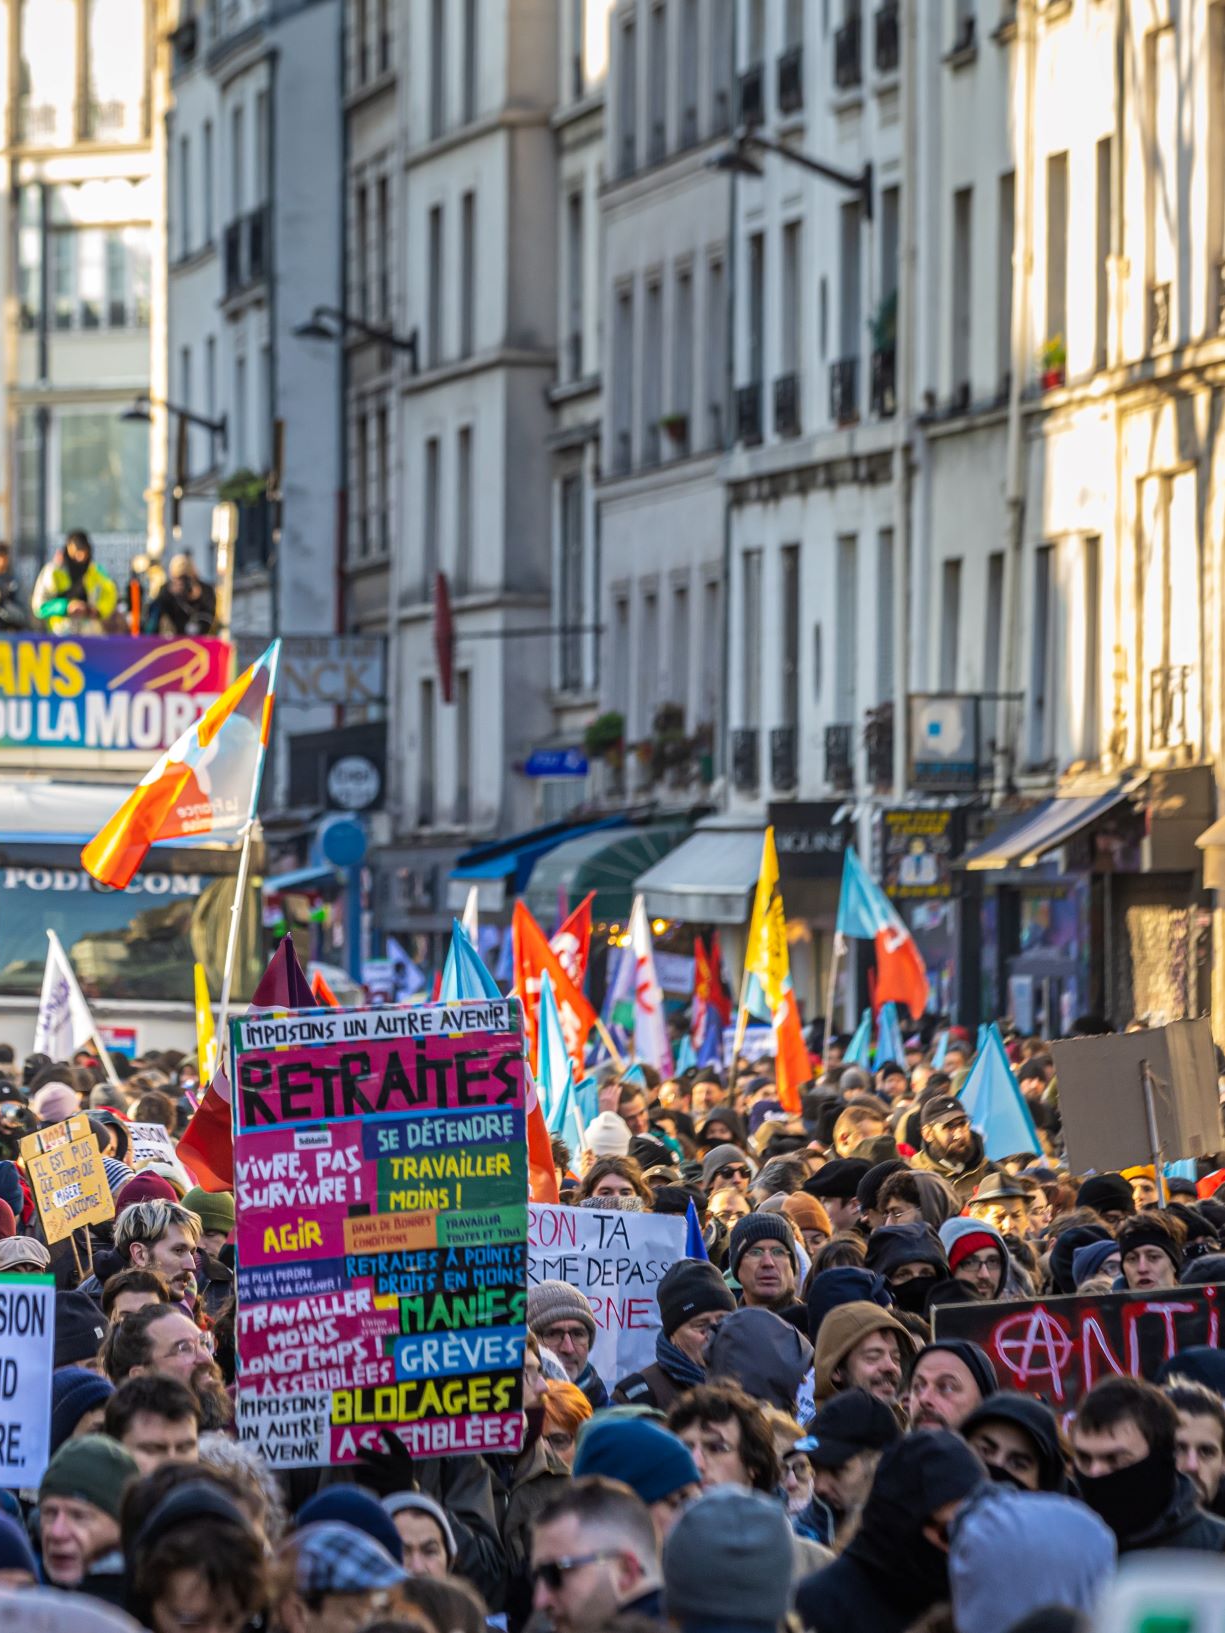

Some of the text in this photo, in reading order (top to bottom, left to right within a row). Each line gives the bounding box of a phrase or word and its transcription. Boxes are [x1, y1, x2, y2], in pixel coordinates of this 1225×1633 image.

[38, 699, 81, 742] LA
[344, 1018, 367, 1037] UN
[374, 1013, 432, 1035] AUTRE
[377, 1129, 400, 1152] SE
[316, 1145, 362, 1179] PAS
[352, 1214, 432, 1236] DANS DE BONNES
[447, 1227, 522, 1244] TOUTES ET TOUS
[593, 1214, 630, 1250] TA
[252, 1271, 274, 1284] PLUS
[277, 1267, 313, 1283] PERDRE
[444, 1270, 468, 1291] EN
[280, 1282, 293, 1295] LA
[238, 1337, 369, 1377] LONGTEMPS
[401, 1335, 526, 1375] GRÈVES
[331, 1376, 516, 1425] BLOCAGES
[267, 1417, 325, 1440] AUTRE
